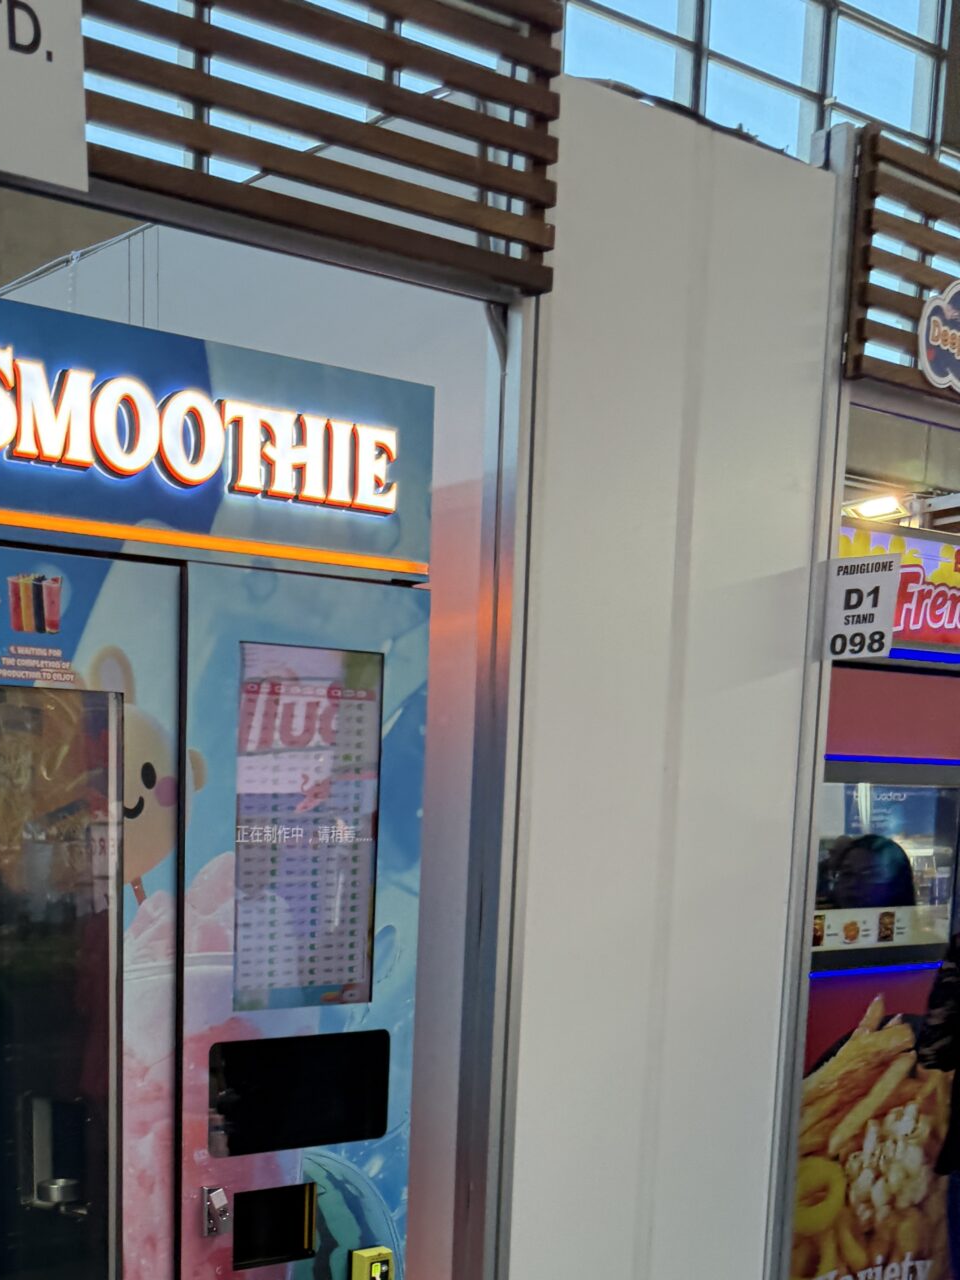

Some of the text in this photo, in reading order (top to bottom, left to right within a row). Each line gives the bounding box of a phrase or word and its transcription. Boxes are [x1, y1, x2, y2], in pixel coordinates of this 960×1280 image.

[929, 316, 960, 360] Dee
[836, 561, 894, 576] PADIGLIONE
[843, 585, 880, 611] D1
[843, 613, 875, 626] STAND
[829, 631, 886, 656] 098
